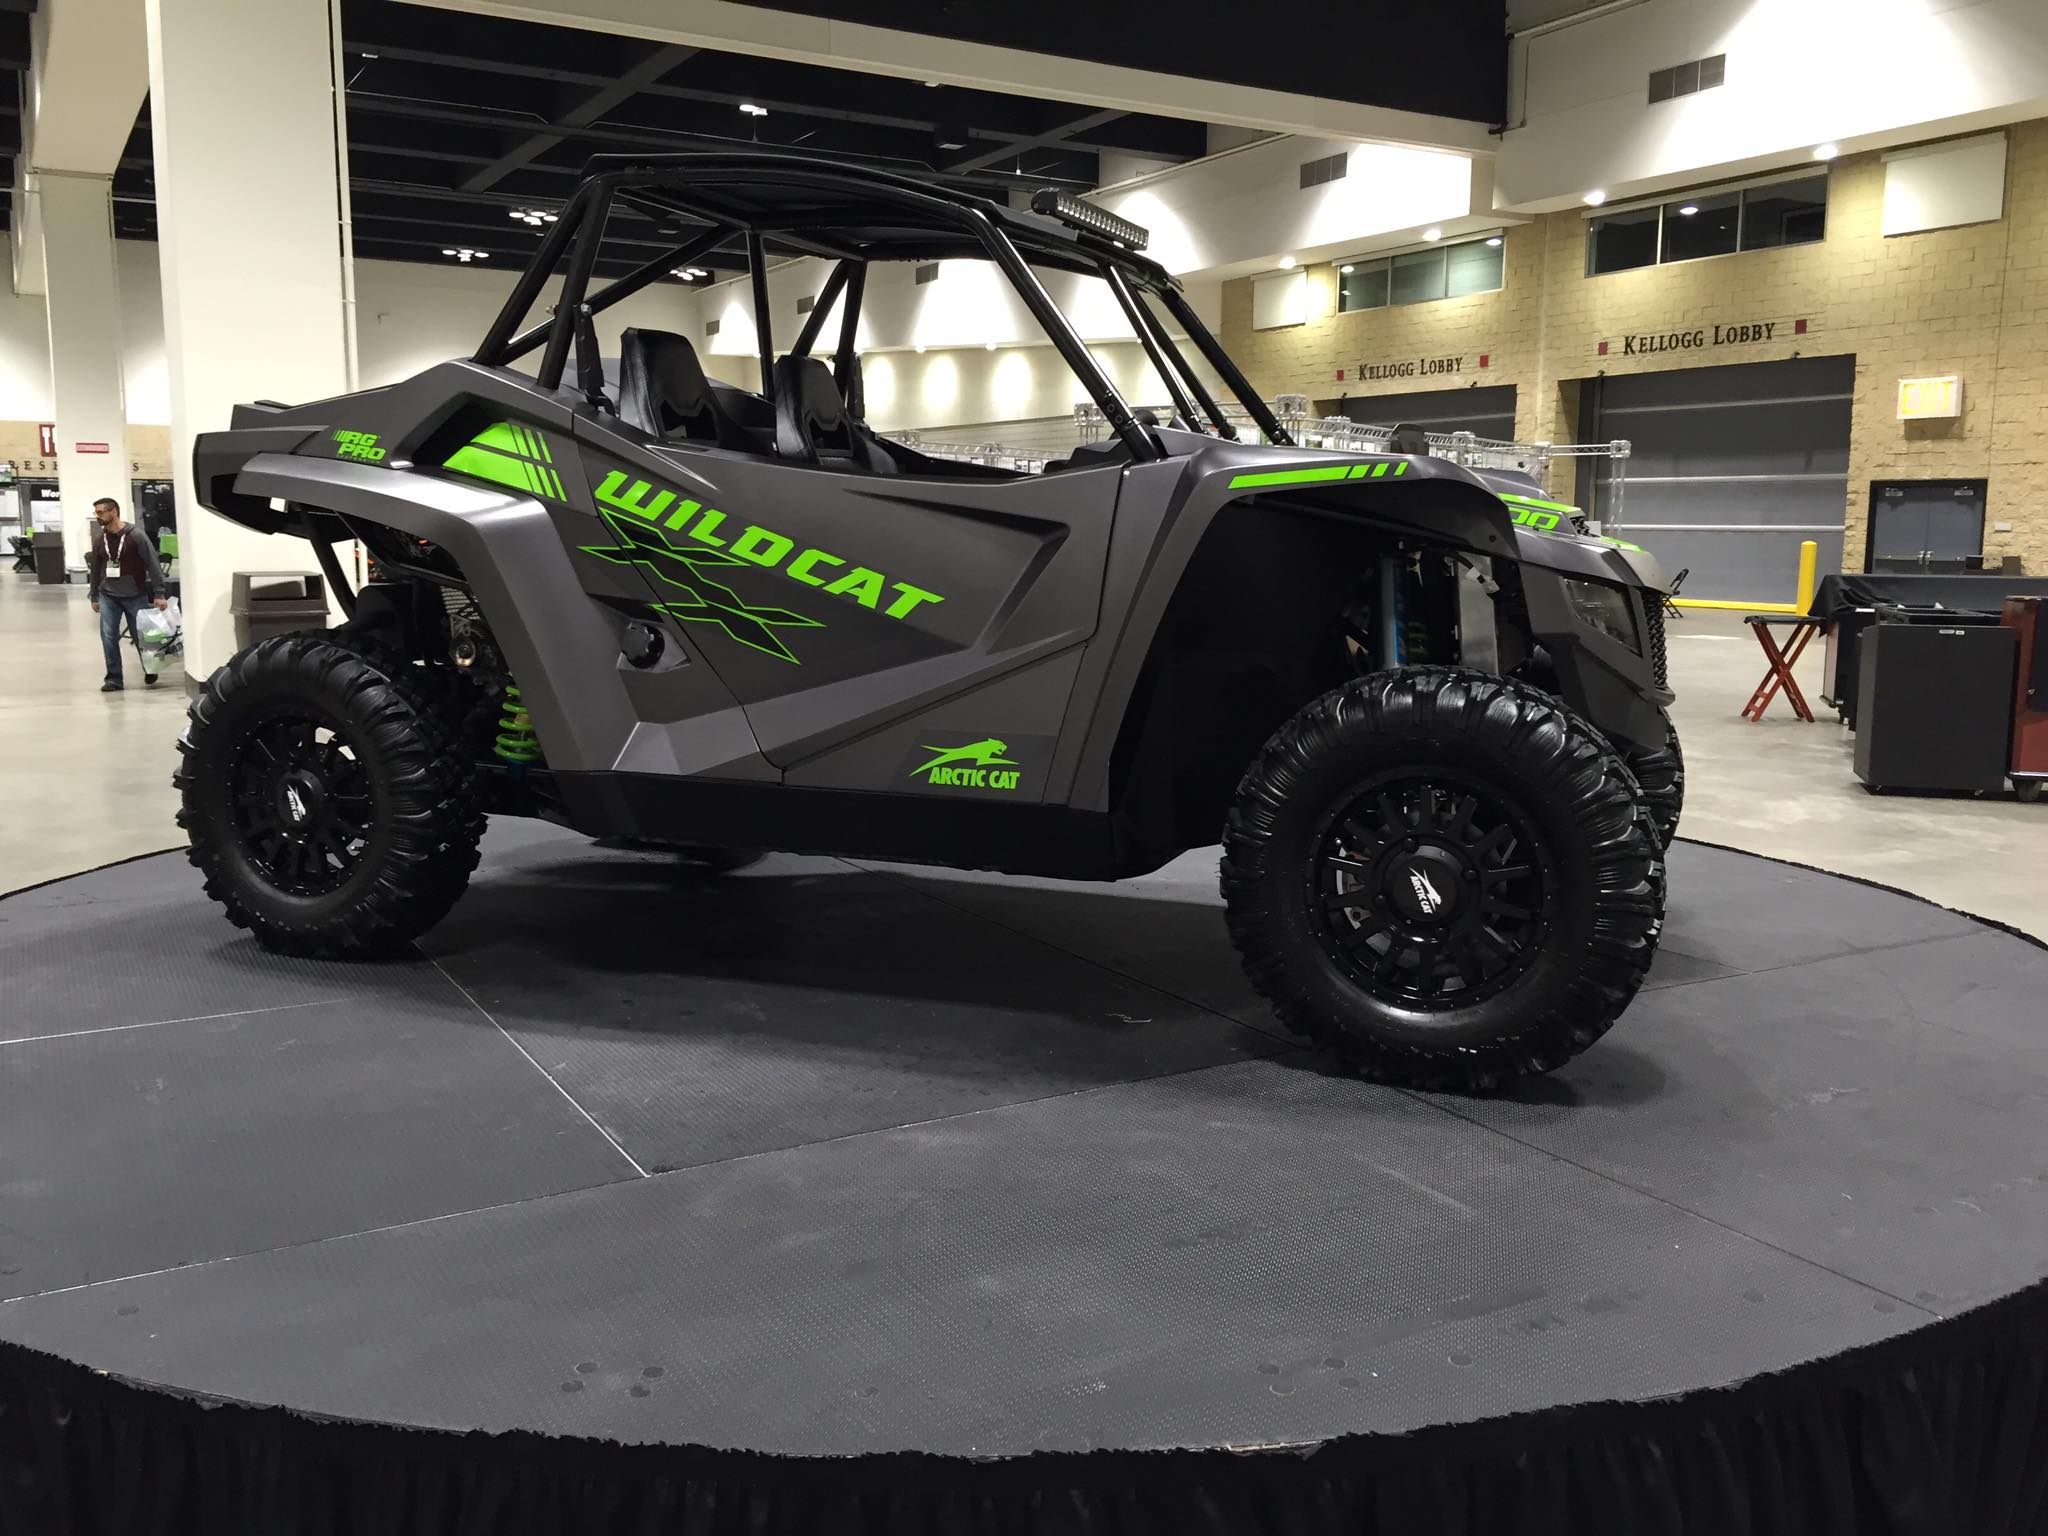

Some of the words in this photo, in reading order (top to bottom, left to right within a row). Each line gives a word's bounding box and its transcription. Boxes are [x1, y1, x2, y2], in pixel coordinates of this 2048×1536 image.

[1623, 330, 1704, 356] KELLOGG
[1713, 322, 1776, 345] LOBBY
[1358, 363, 1414, 381] KELLOGG
[1420, 357, 1463, 375] LOBBY
[337, 442, 386, 461] PRO
[595, 470, 945, 620] WILDCAT
[928, 766, 987, 787] ARCTIC
[989, 770, 1021, 789] CAT
[1409, 875, 1428, 901] ARCTIC
[1420, 900, 1433, 914] CAT
